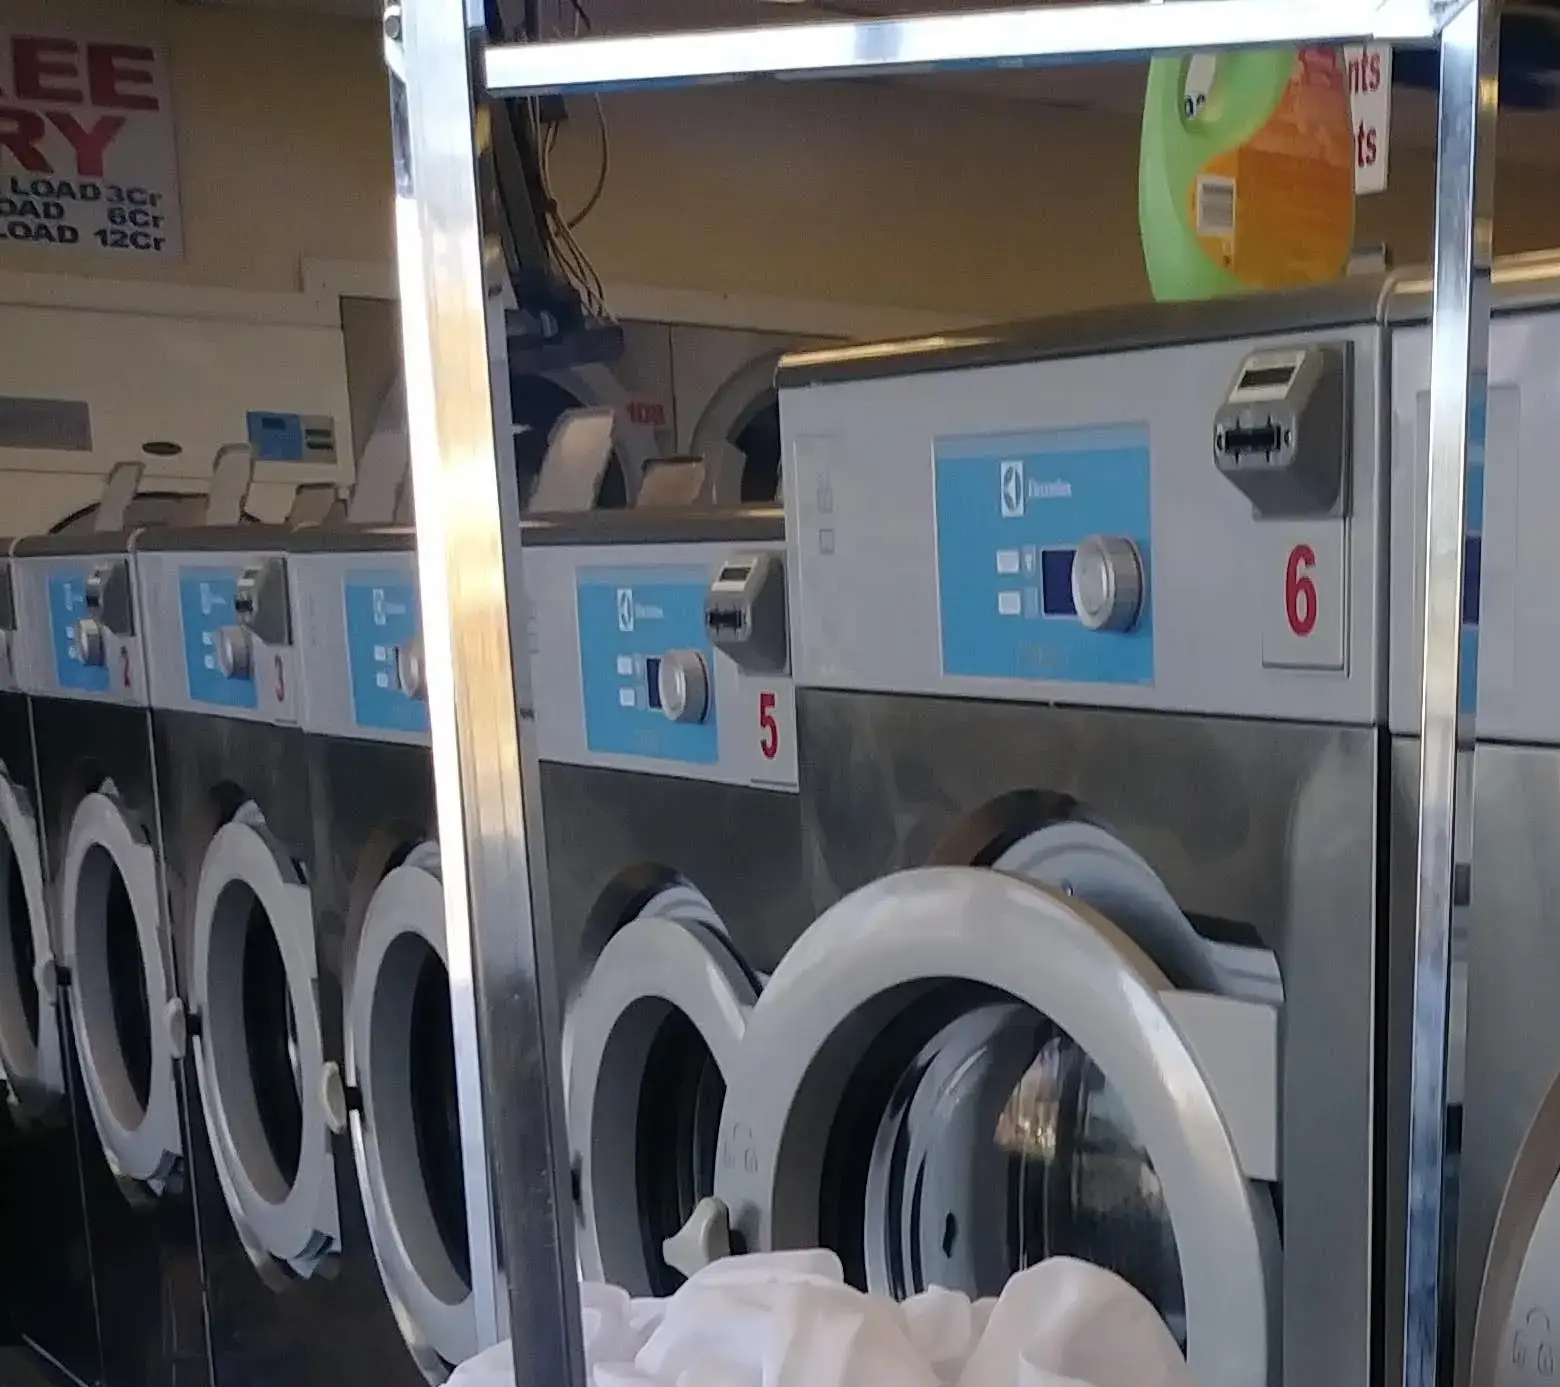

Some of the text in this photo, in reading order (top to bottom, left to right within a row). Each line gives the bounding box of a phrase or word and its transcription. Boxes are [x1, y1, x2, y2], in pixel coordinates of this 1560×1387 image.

[0, 36, 159, 112] EE
[1353, 120, 1377, 167] ts
[10, 176, 101, 200] LOAD
[94, 228, 166, 251] 12Cr
[1285, 543, 1317, 637] 6
[274, 653, 286, 702] 3
[759, 691, 779, 760] 5
